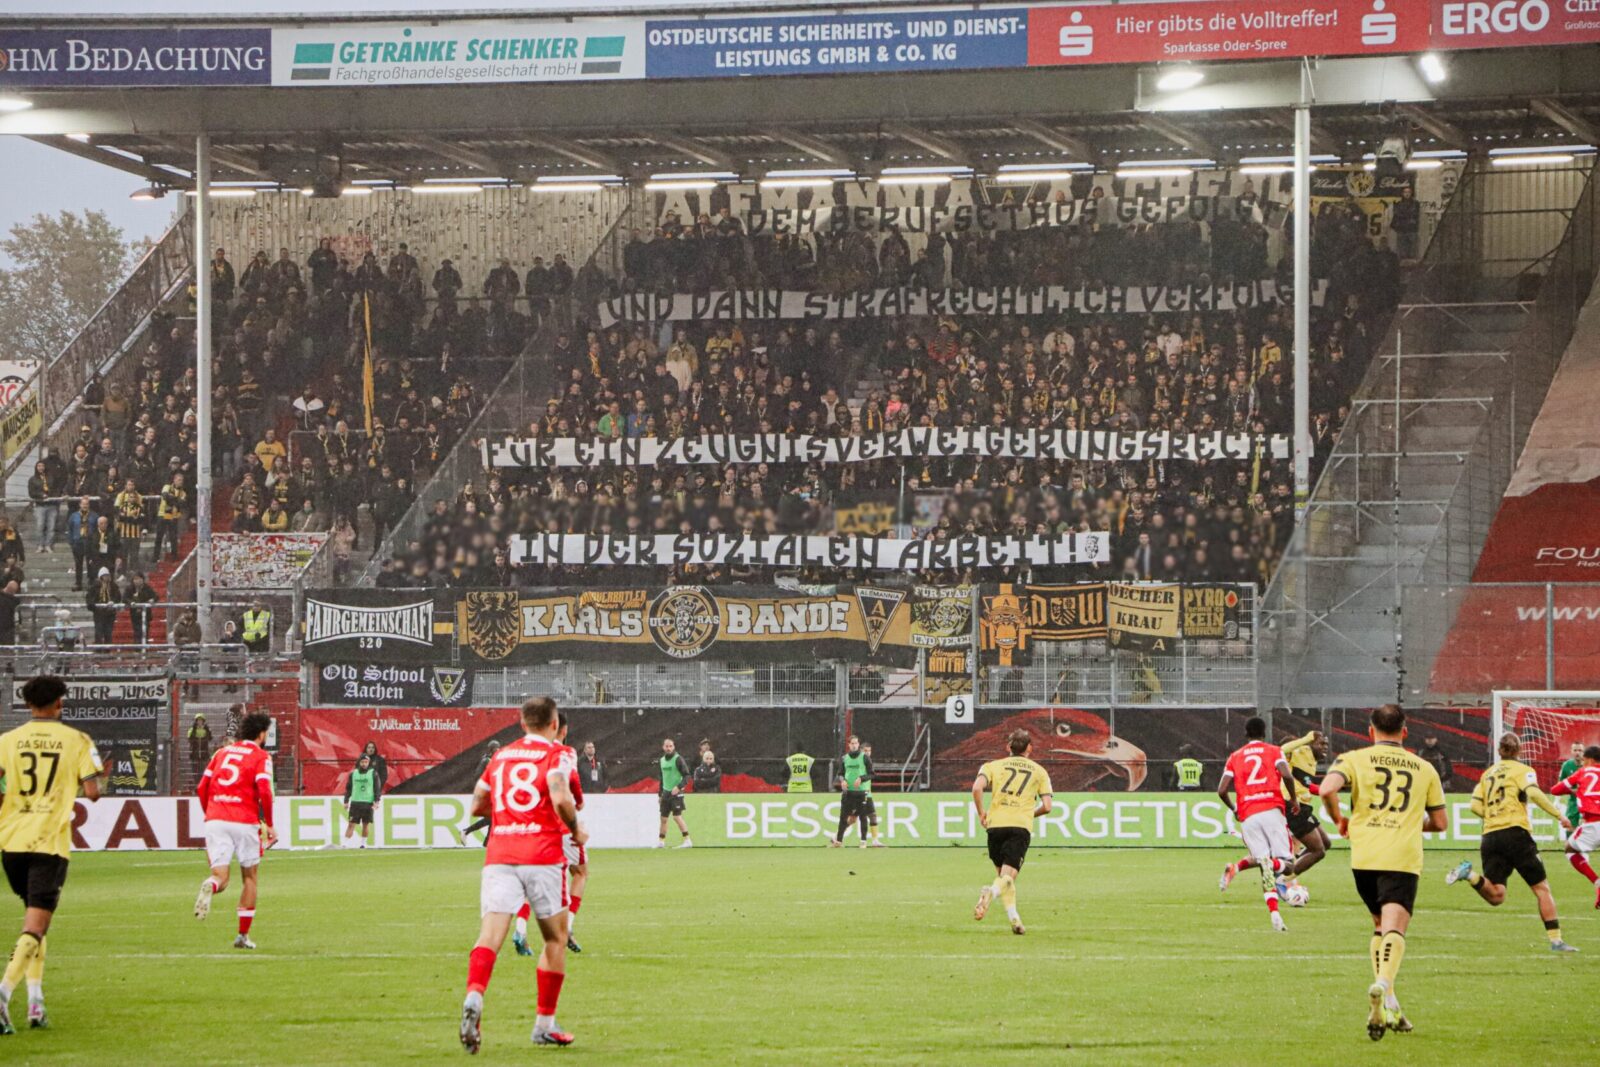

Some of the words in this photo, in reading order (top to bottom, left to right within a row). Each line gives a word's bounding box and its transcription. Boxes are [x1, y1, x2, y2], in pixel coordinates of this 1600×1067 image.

[1115, 15, 1154, 34] Hier
[1158, 15, 1209, 36] gibts
[1211, 14, 1238, 31] die
[1240, 10, 1339, 30] Volltreffer!
[1442, 0, 1550, 35] ERGO
[649, 26, 772, 46] OSTDEUTSCHE
[779, 23, 901, 43] SICHERHEITS-
[907, 20, 946, 38] UND
[954, 17, 1026, 36] DIENST-
[66, 40, 266, 72] BEDACHUNG
[338, 28, 457, 64] GETRÄNKE
[466, 37, 578, 61] SCHENKER
[715, 49, 811, 68] LEISTUNGS
[818, 47, 871, 64] GMBH
[877, 46, 889, 62] &
[896, 44, 926, 62] CO.
[932, 43, 957, 60] KG
[1163, 40, 1220, 54] Sparkasse
[1223, 39, 1287, 53] Oder-Spree
[336, 63, 538, 83] Fachgroßhandelsgesellschaft
[544, 61, 578, 76] mbH
[607, 294, 674, 321] UND
[691, 291, 782, 320] DANN
[804, 288, 1127, 318] STRAFRECHTLICH
[487, 437, 556, 467] FÜR
[573, 438, 641, 466] EIN
[520, 534, 564, 564] IN
[583, 535, 657, 564] DER
[673, 534, 879, 568] SOZIALEN
[899, 533, 1078, 568] ARBEIT!
[871, 600, 886, 617] A
[1183, 588, 1225, 608] PYRO
[305, 602, 434, 643] FAHRGEMEINSCHAFT
[522, 602, 645, 637] KARLS
[726, 602, 848, 634] BANDE
[1116, 611, 1163, 630] KRAU
[1184, 613, 1225, 627] KEIN
[359, 635, 384, 649] 520
[322, 665, 360, 683] Old
[364, 663, 426, 684] School
[344, 682, 404, 700] Aachen
[62, 707, 118, 718] EUREGIO
[121, 706, 156, 718] KRAU
[954, 700, 965, 718] 9
[33, 740, 63, 750] SILVA
[19, 752, 60, 797] 37
[118, 761, 133, 774] KA
[217, 753, 244, 787] 5
[792, 765, 808, 774] 264
[1184, 770, 1197, 779] 111
[1244, 755, 1268, 786] 2
[1370, 755, 1421, 771] WEGMANN
[493, 761, 541, 814] 18
[1000, 767, 1033, 797] 27
[1369, 766, 1413, 813] 33
[726, 801, 919, 838] BESSER
